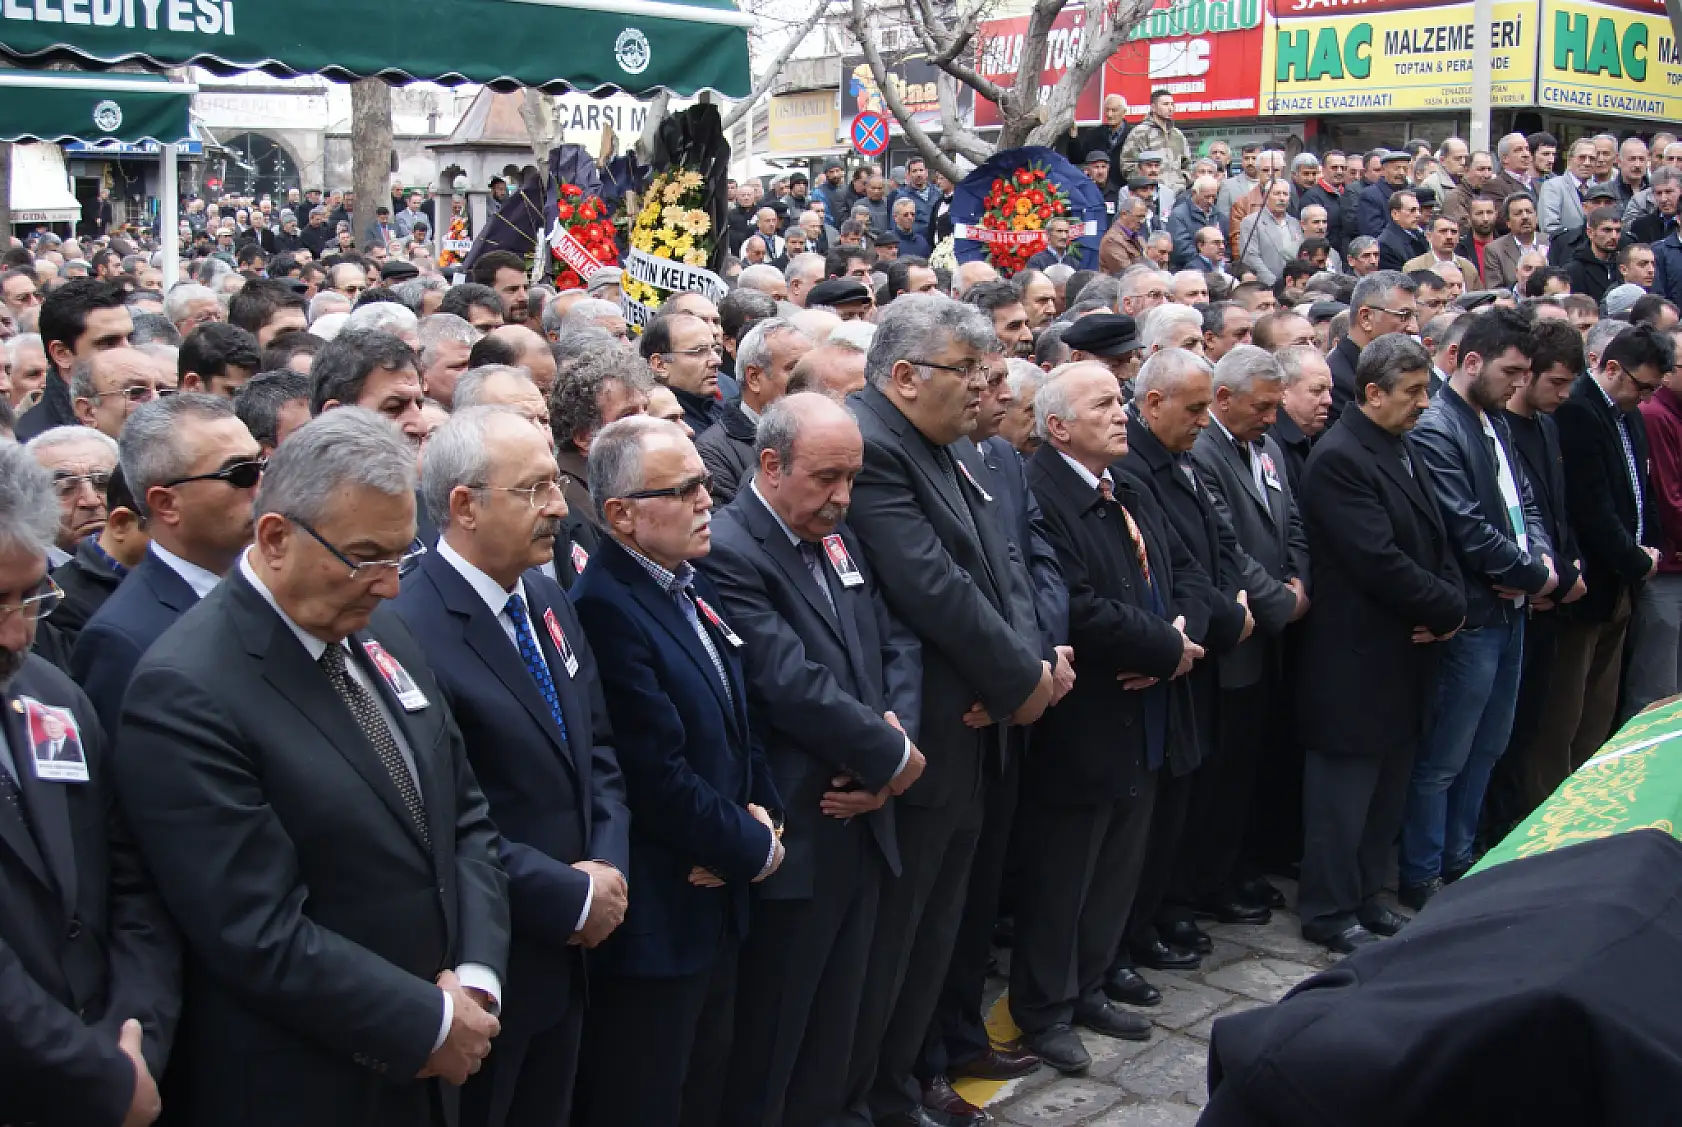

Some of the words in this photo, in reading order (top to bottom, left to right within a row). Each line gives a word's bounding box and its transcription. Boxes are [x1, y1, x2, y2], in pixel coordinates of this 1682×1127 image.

[1384, 13, 1521, 56] MALZEMEERİ
[1554, 10, 1649, 82] HAC
[1276, 23, 1373, 83] HAC
[1395, 61, 1433, 75] TOPTAN
[1267, 96, 1313, 111] CENAZE
[1318, 93, 1393, 109] LEVAZIMATI
[1543, 87, 1593, 106] CENAZE
[1597, 94, 1665, 115] LEVAZIMATI
